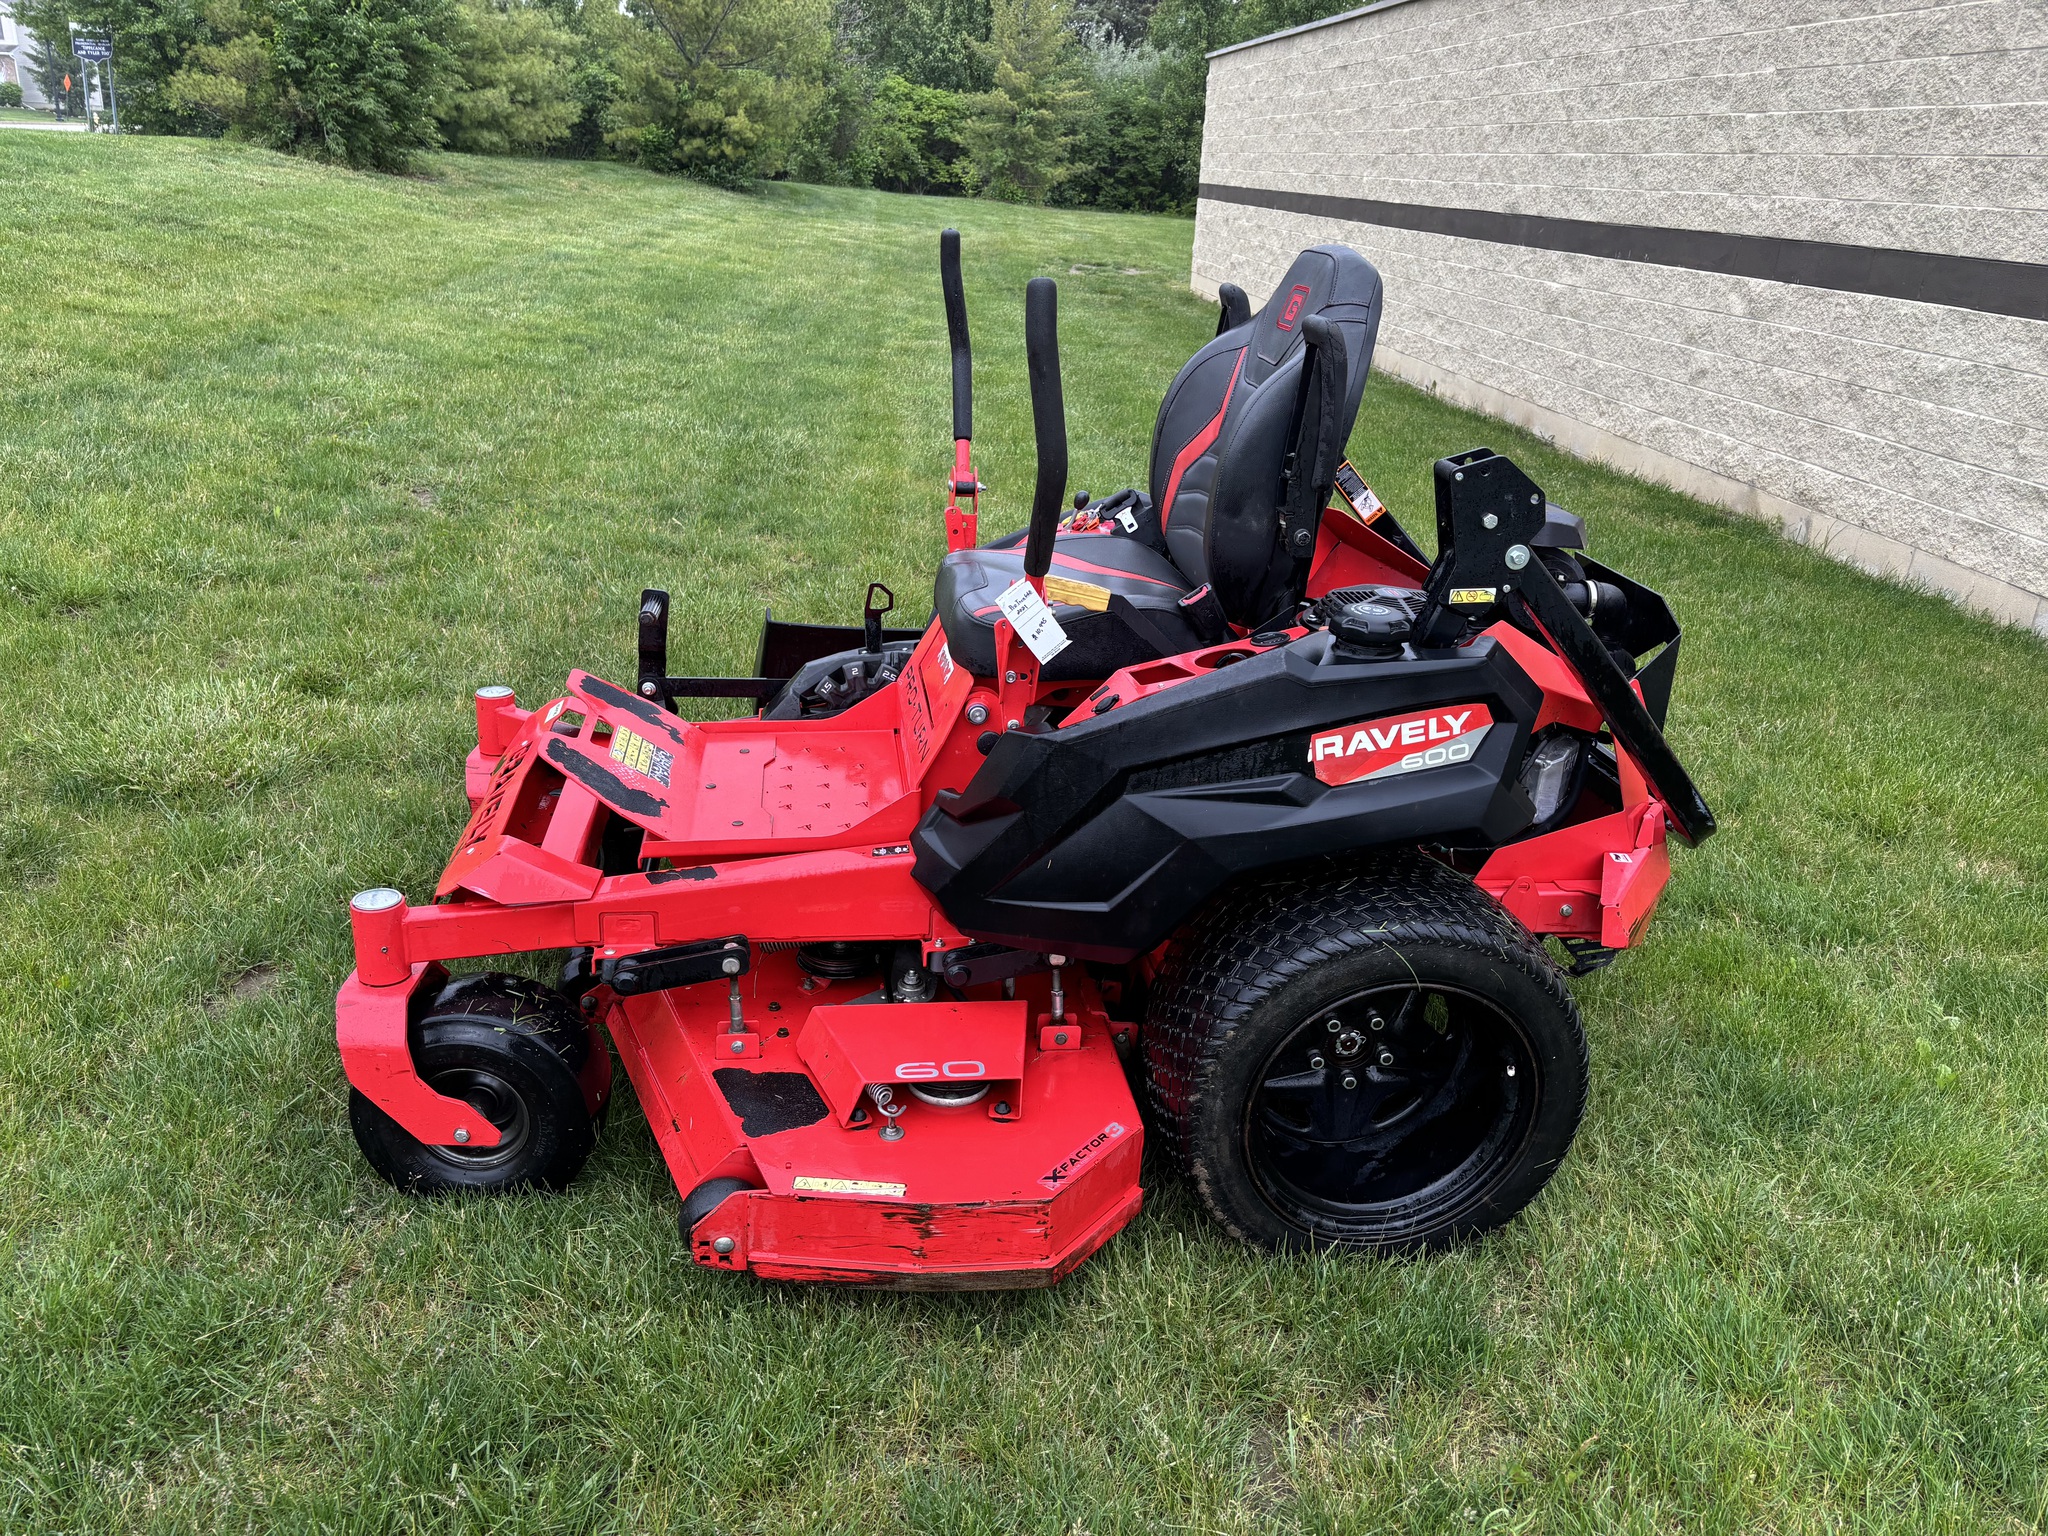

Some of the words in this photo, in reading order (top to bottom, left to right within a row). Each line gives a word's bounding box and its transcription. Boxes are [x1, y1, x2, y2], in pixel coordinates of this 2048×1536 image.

[851, 667, 859, 676] 2
[1307, 711, 1473, 762] RAVELY
[1401, 743, 1470, 769] 600
[895, 1060, 985, 1078] 60
